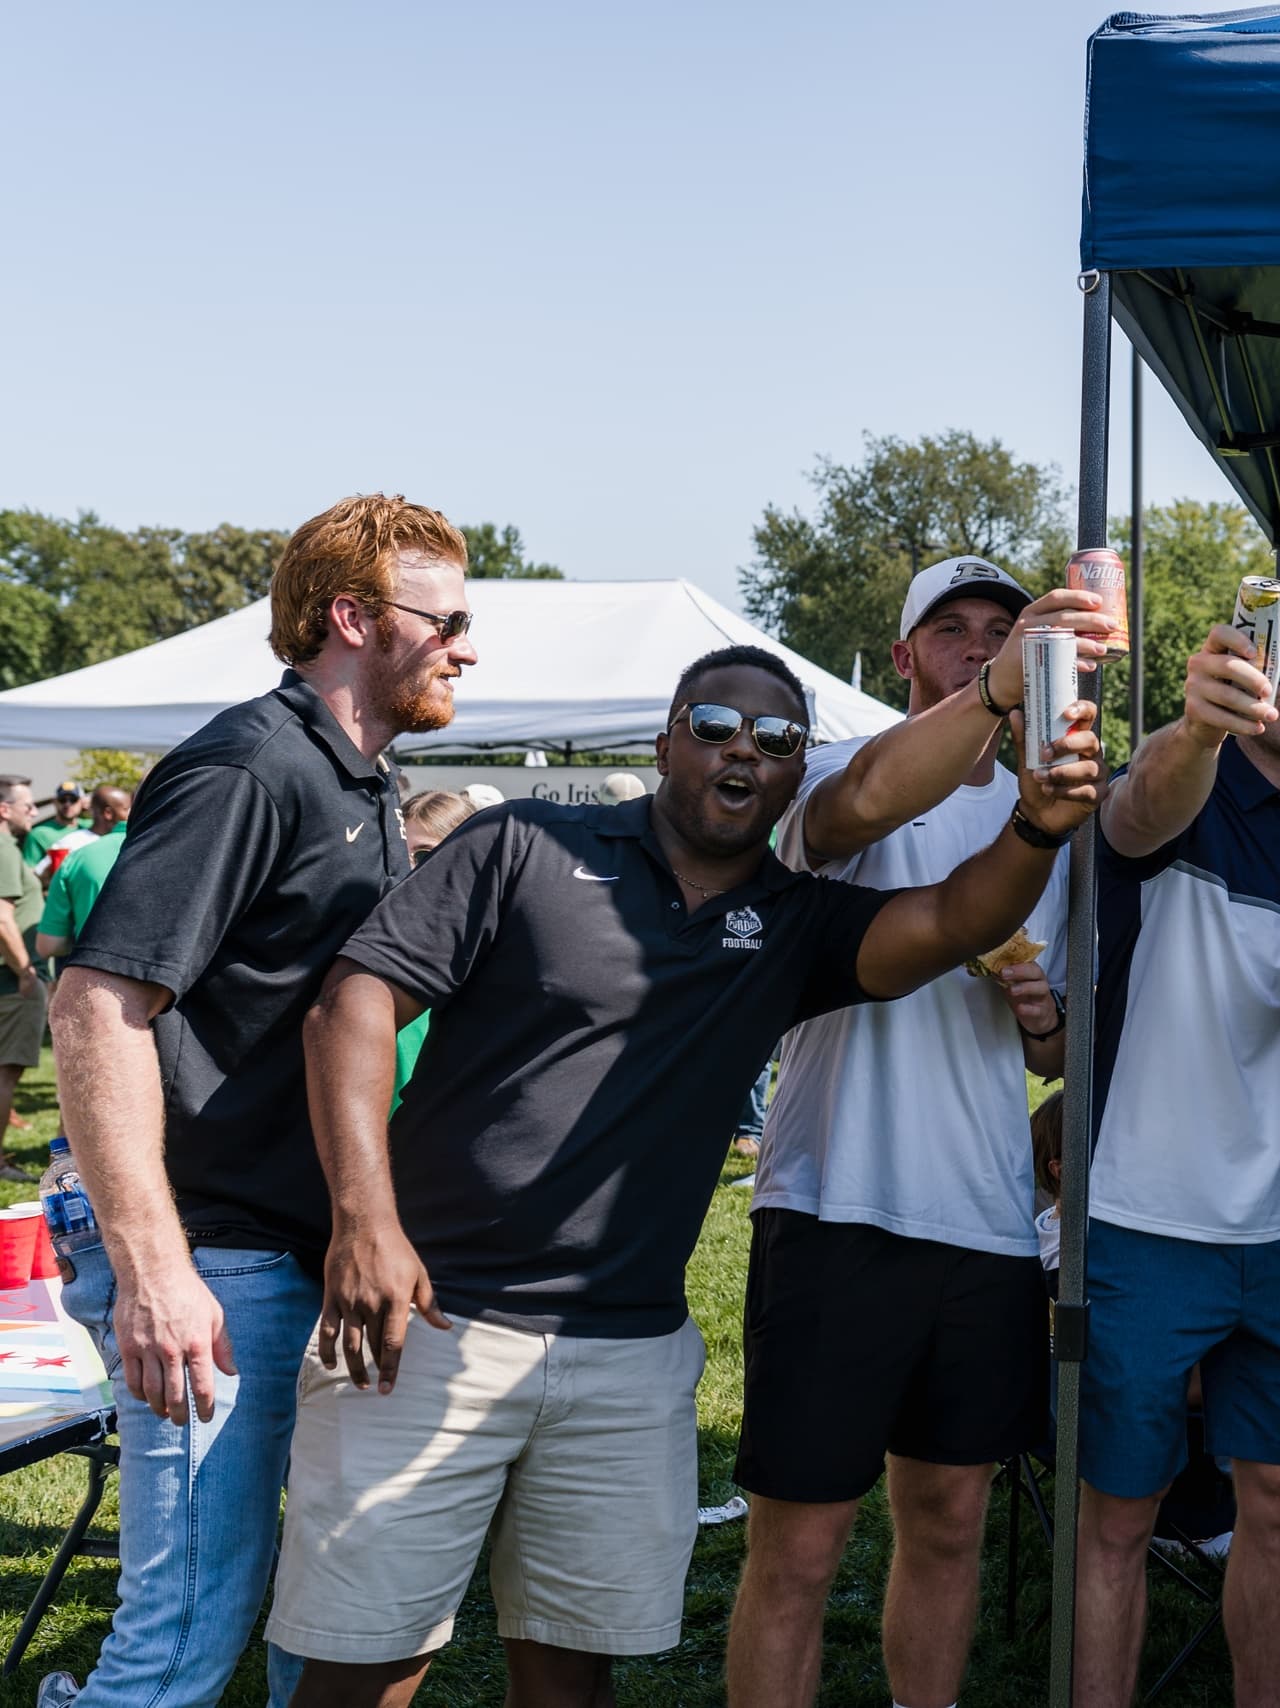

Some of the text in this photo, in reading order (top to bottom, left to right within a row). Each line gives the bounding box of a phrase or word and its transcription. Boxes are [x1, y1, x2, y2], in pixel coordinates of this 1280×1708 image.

[1076, 562, 1125, 580] Natura
[532, 783, 599, 803] Go Iris
[722, 938, 763, 949] FOOTBALL
